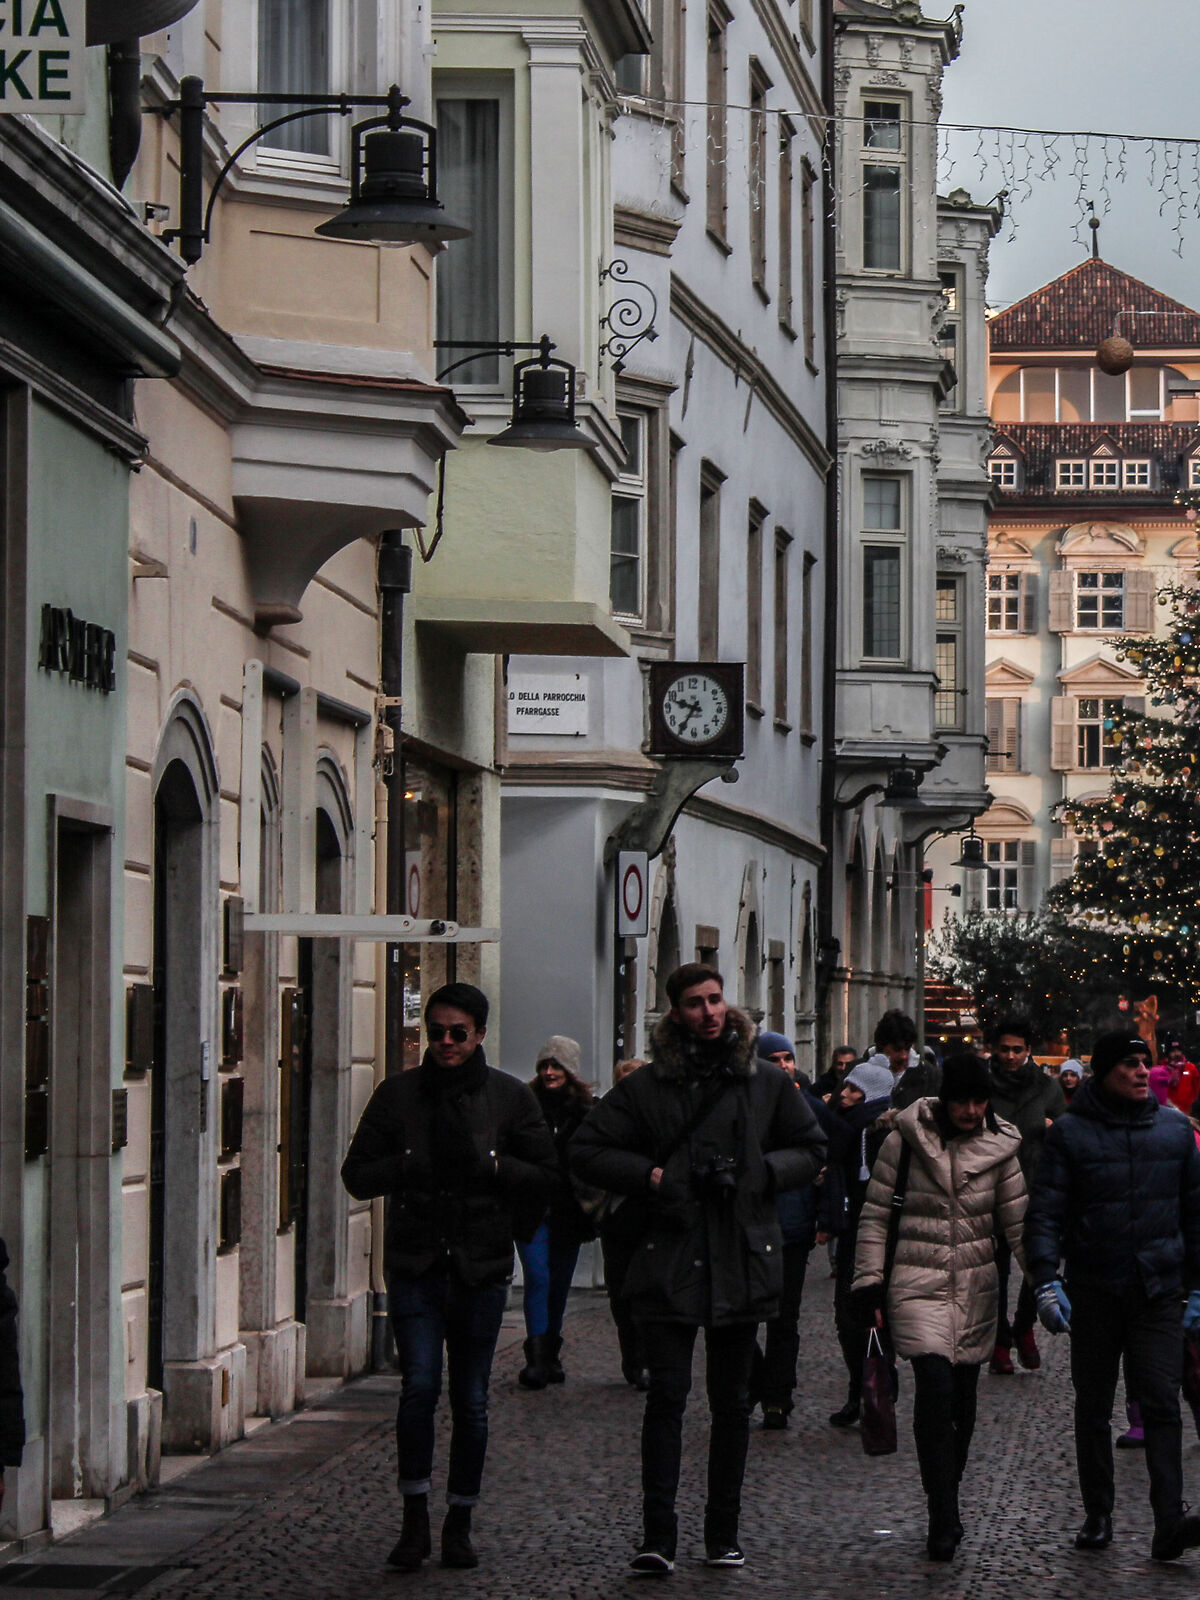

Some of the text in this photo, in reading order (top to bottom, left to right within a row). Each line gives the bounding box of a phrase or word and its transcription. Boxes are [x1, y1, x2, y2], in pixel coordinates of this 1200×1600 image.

[0, 0, 70, 36] IA
[688, 677, 698, 689] 12
[507, 692, 586, 702] O DELLA PARROCCHIA
[668, 690, 677, 702] 10
[516, 707, 560, 716] PFARRGASSE
[664, 702, 672, 714] 9
[669, 714, 676, 727] 8
[711, 714, 720, 726] 4
[690, 727, 697, 738] 6
